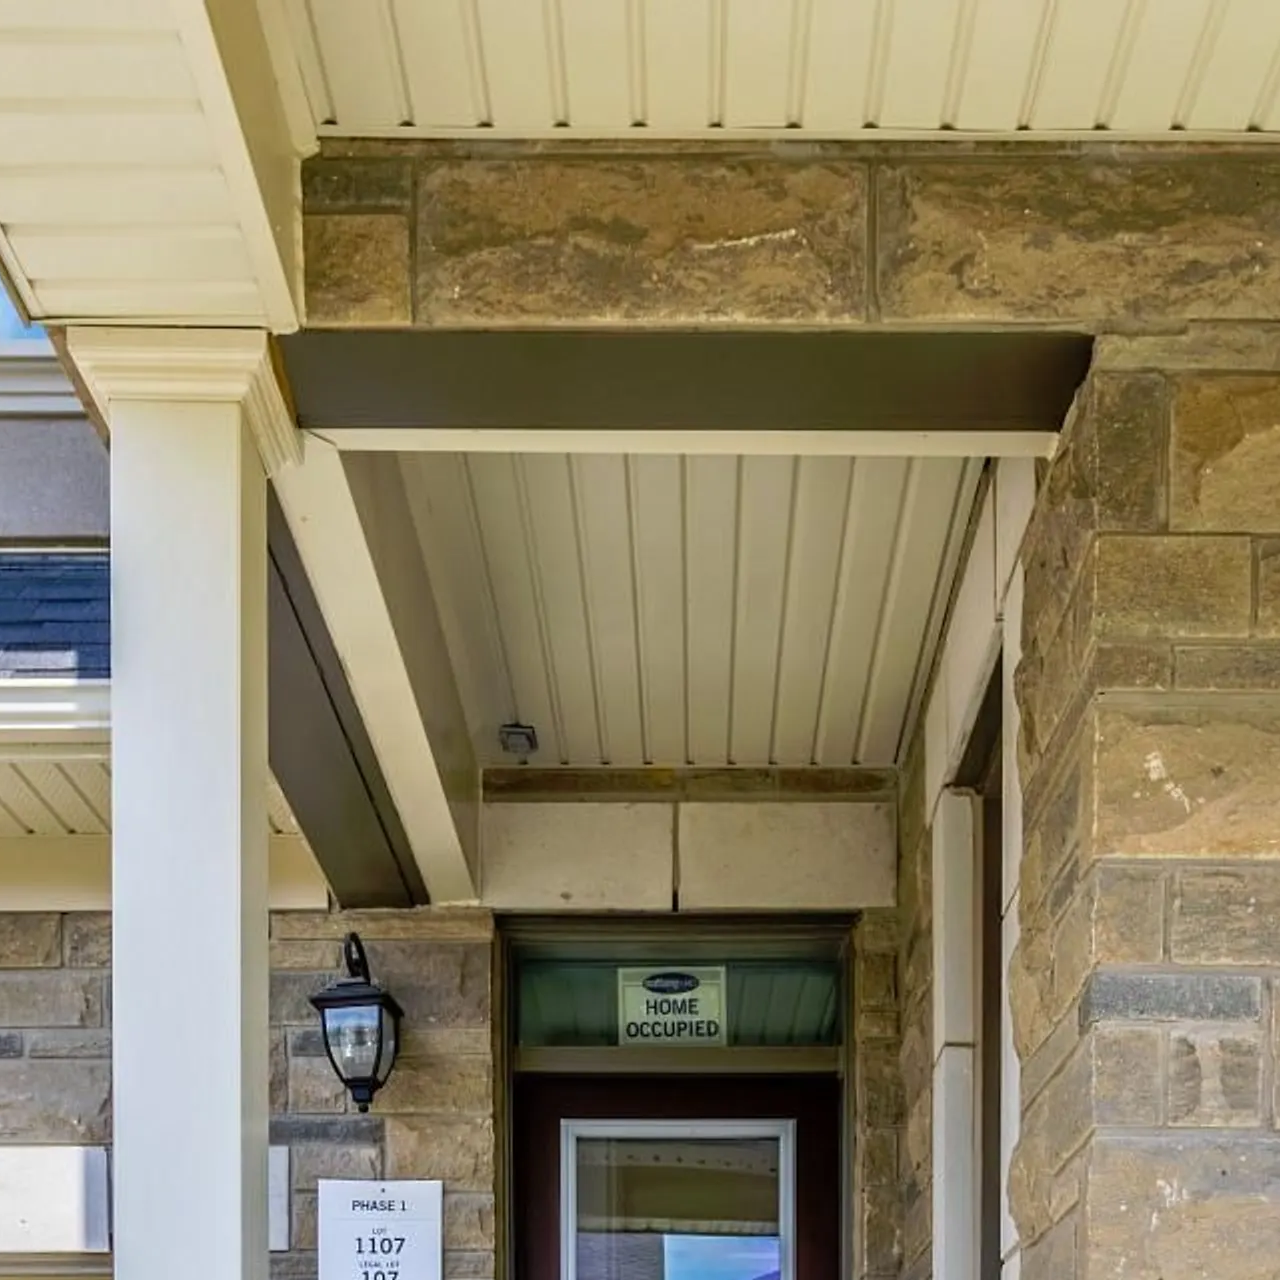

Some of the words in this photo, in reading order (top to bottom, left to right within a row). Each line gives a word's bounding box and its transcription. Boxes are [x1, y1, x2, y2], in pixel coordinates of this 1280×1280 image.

[645, 998, 699, 1015] HOME
[626, 1020, 719, 1037] OCCUPIED
[352, 1200, 395, 1211] PHASE
[401, 1200, 407, 1211] 1
[355, 1237, 406, 1255] 1107
